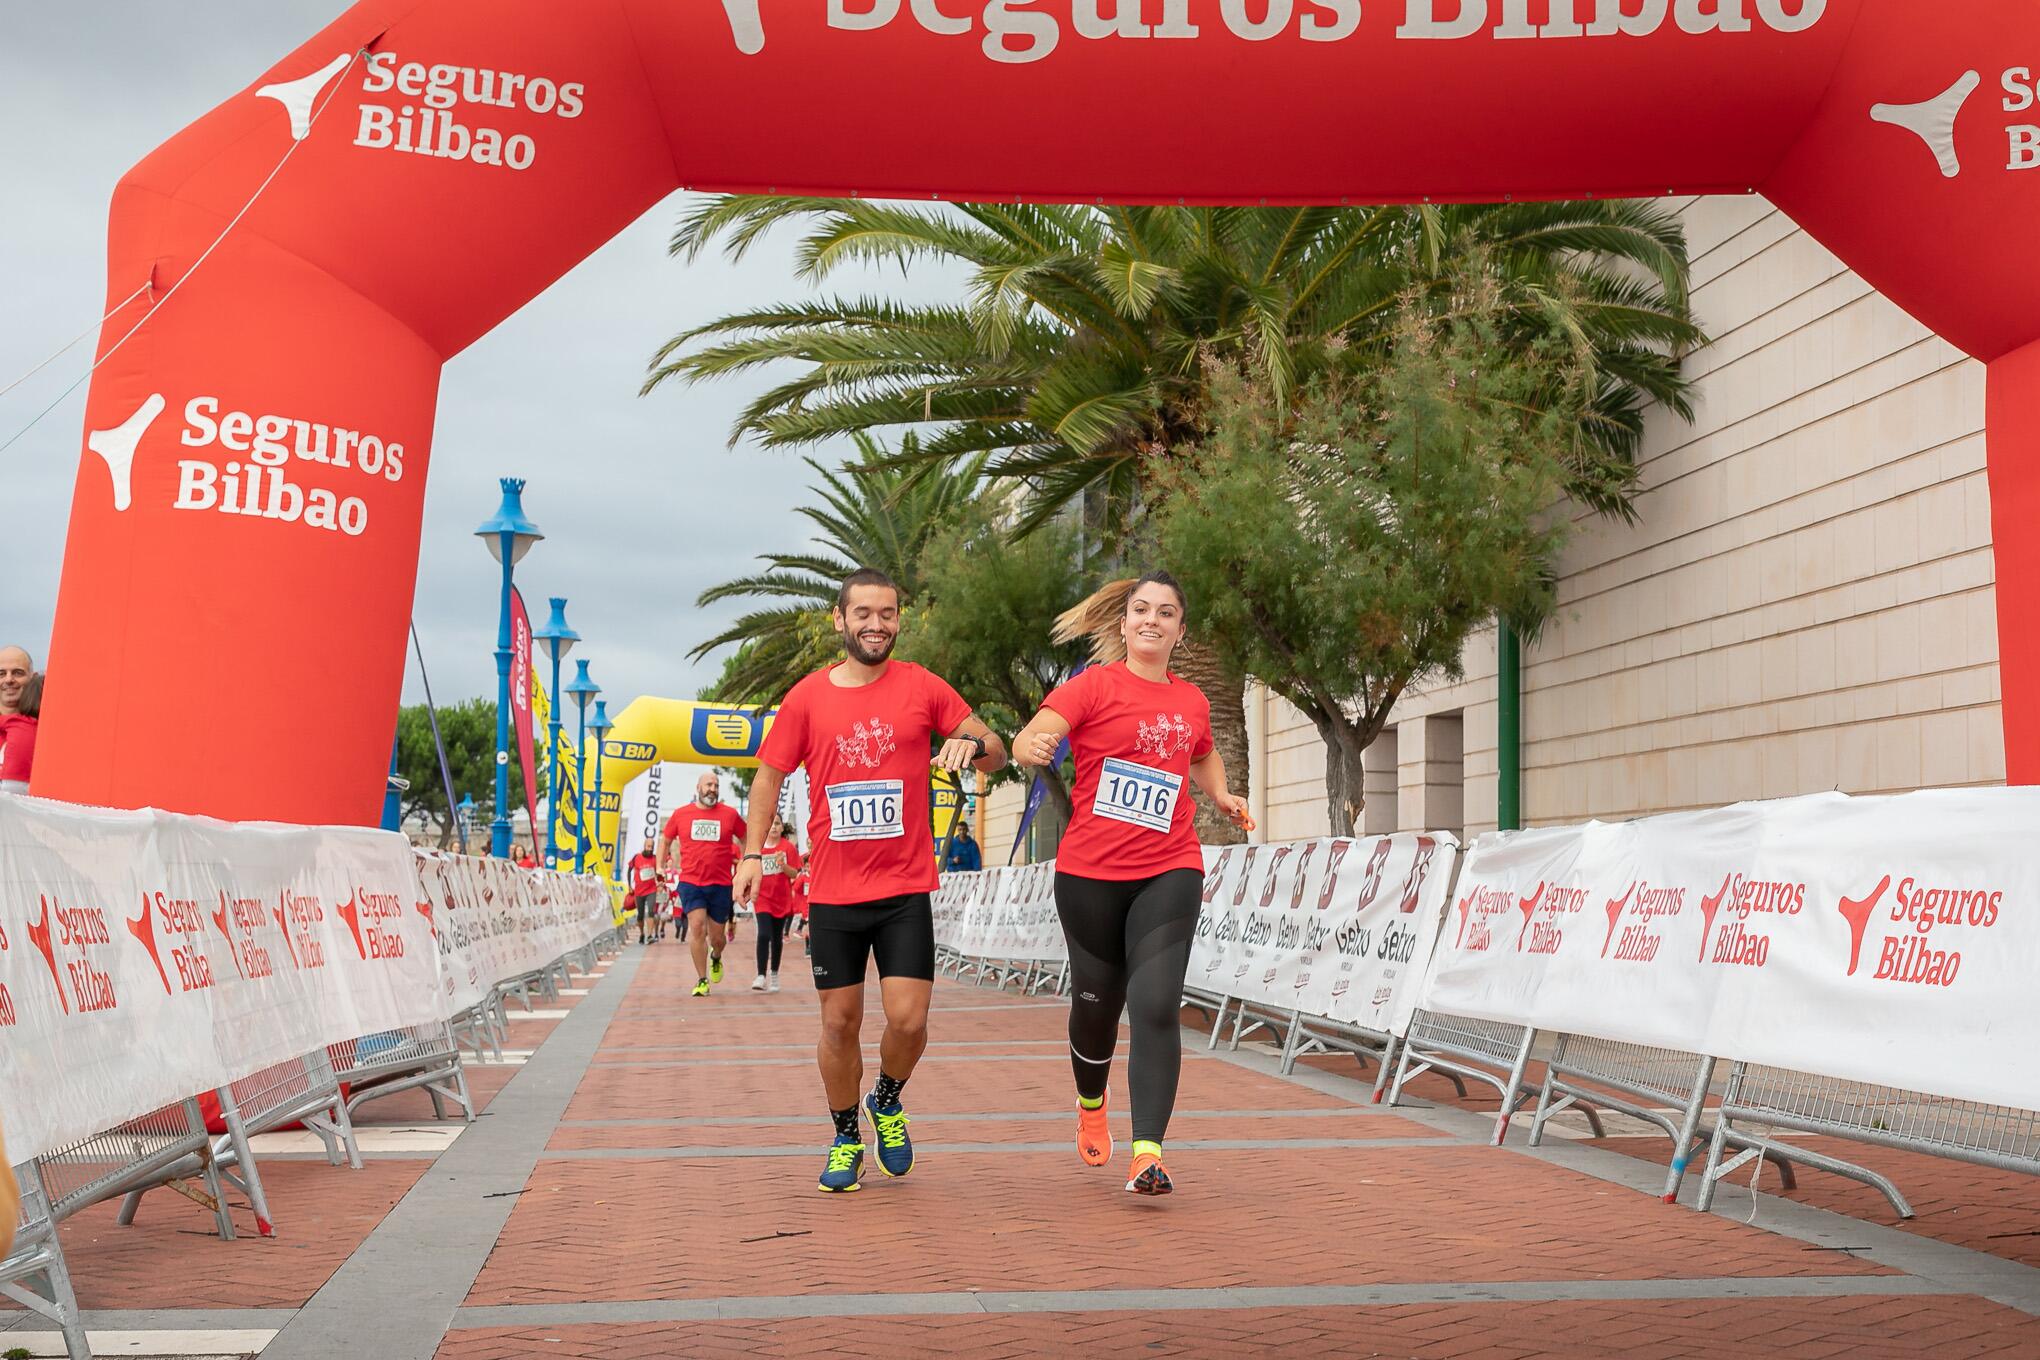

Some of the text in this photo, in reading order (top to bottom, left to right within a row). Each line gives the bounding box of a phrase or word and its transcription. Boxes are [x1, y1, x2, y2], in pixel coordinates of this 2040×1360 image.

[362, 51, 585, 119] Seguros
[352, 103, 536, 171] Bilbao
[180, 396, 404, 482] Seguros
[172, 459, 368, 536] Bilbao
[624, 744, 653, 760] BM
[644, 762, 662, 839] CORRE
[838, 796, 895, 826] 1016
[1110, 776, 1170, 816] 1016
[695, 825, 717, 836] 2004
[1630, 880, 1686, 923] Seguros
[1727, 872, 1806, 920] Seguros
[1890, 877, 2003, 934] Seguros
[1242, 911, 1272, 946] Getxo
[1335, 918, 1371, 957] Getxo
[1377, 919, 1417, 964] Getxo
[1614, 925, 1661, 963] Bilbao
[1711, 922, 1769, 967] Bilbao
[1872, 935, 1961, 987] Bilbao
[68, 959, 117, 1013] Bilbao
